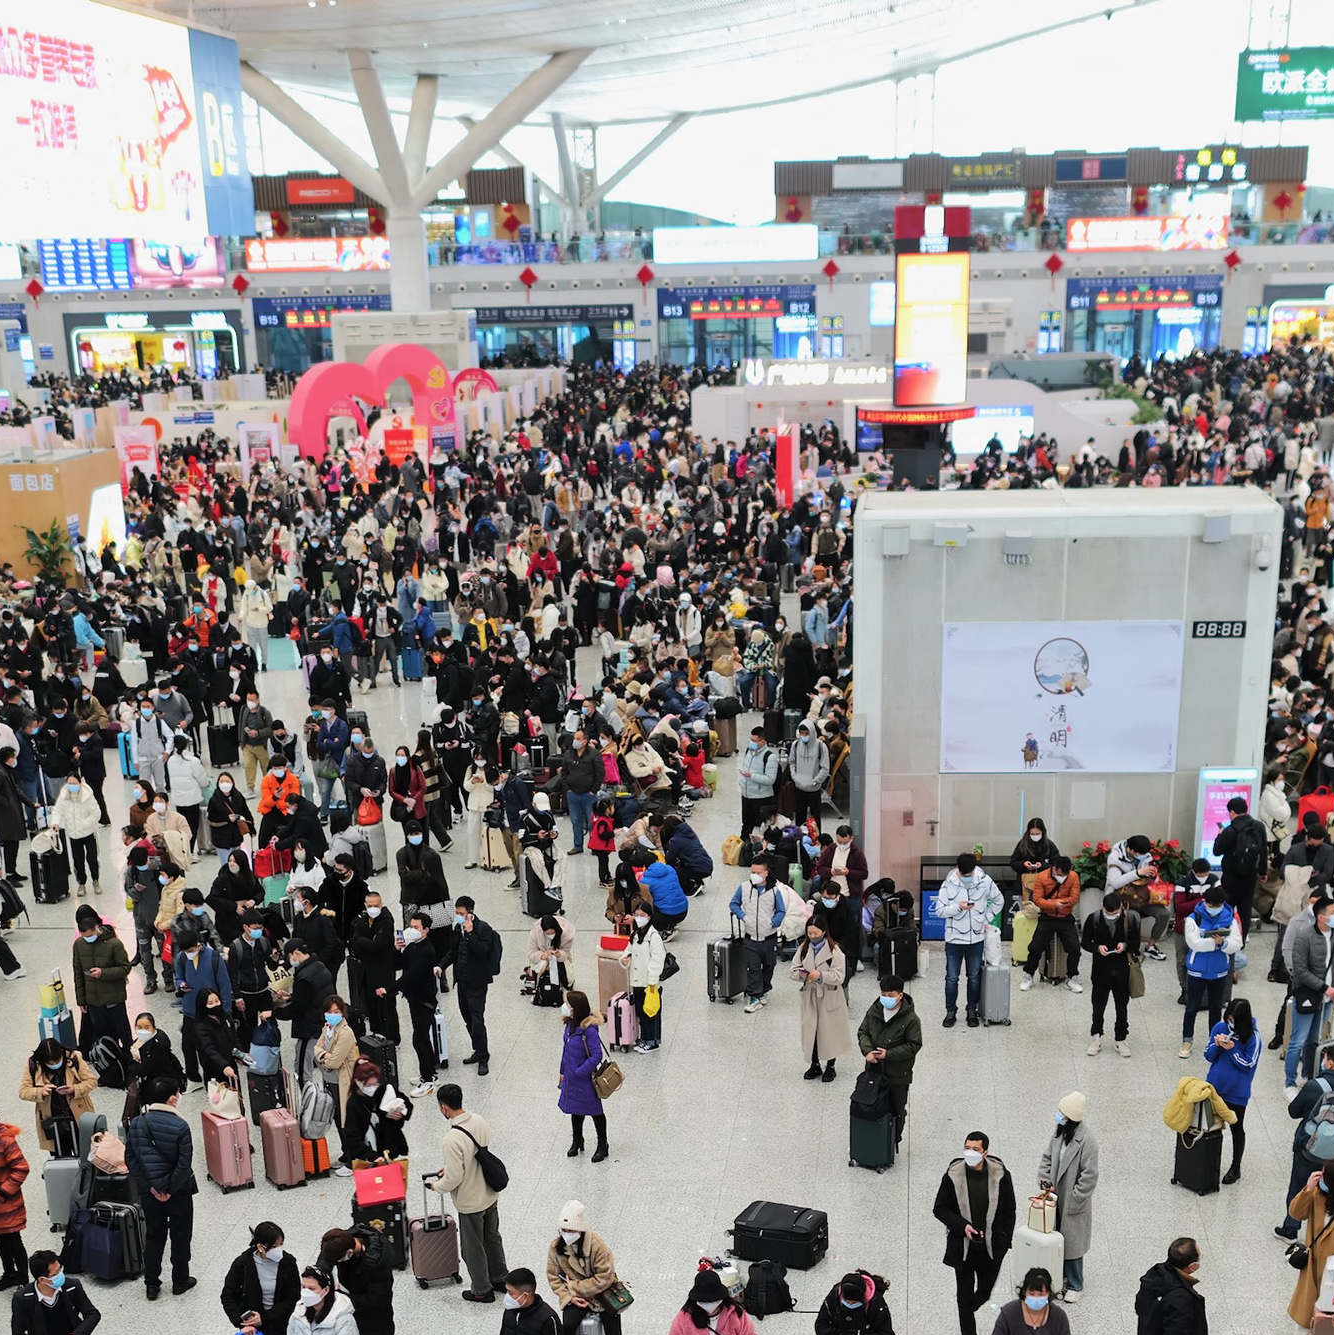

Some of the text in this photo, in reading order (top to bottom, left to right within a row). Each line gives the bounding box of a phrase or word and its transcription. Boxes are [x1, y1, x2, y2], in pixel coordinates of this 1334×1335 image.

[662, 304, 683, 317] B13
[789, 300, 810, 313] B12
[259, 314, 279, 326] B15
[9, 473, 55, 492] 面包店
[1049, 703, 1068, 749] 清明
